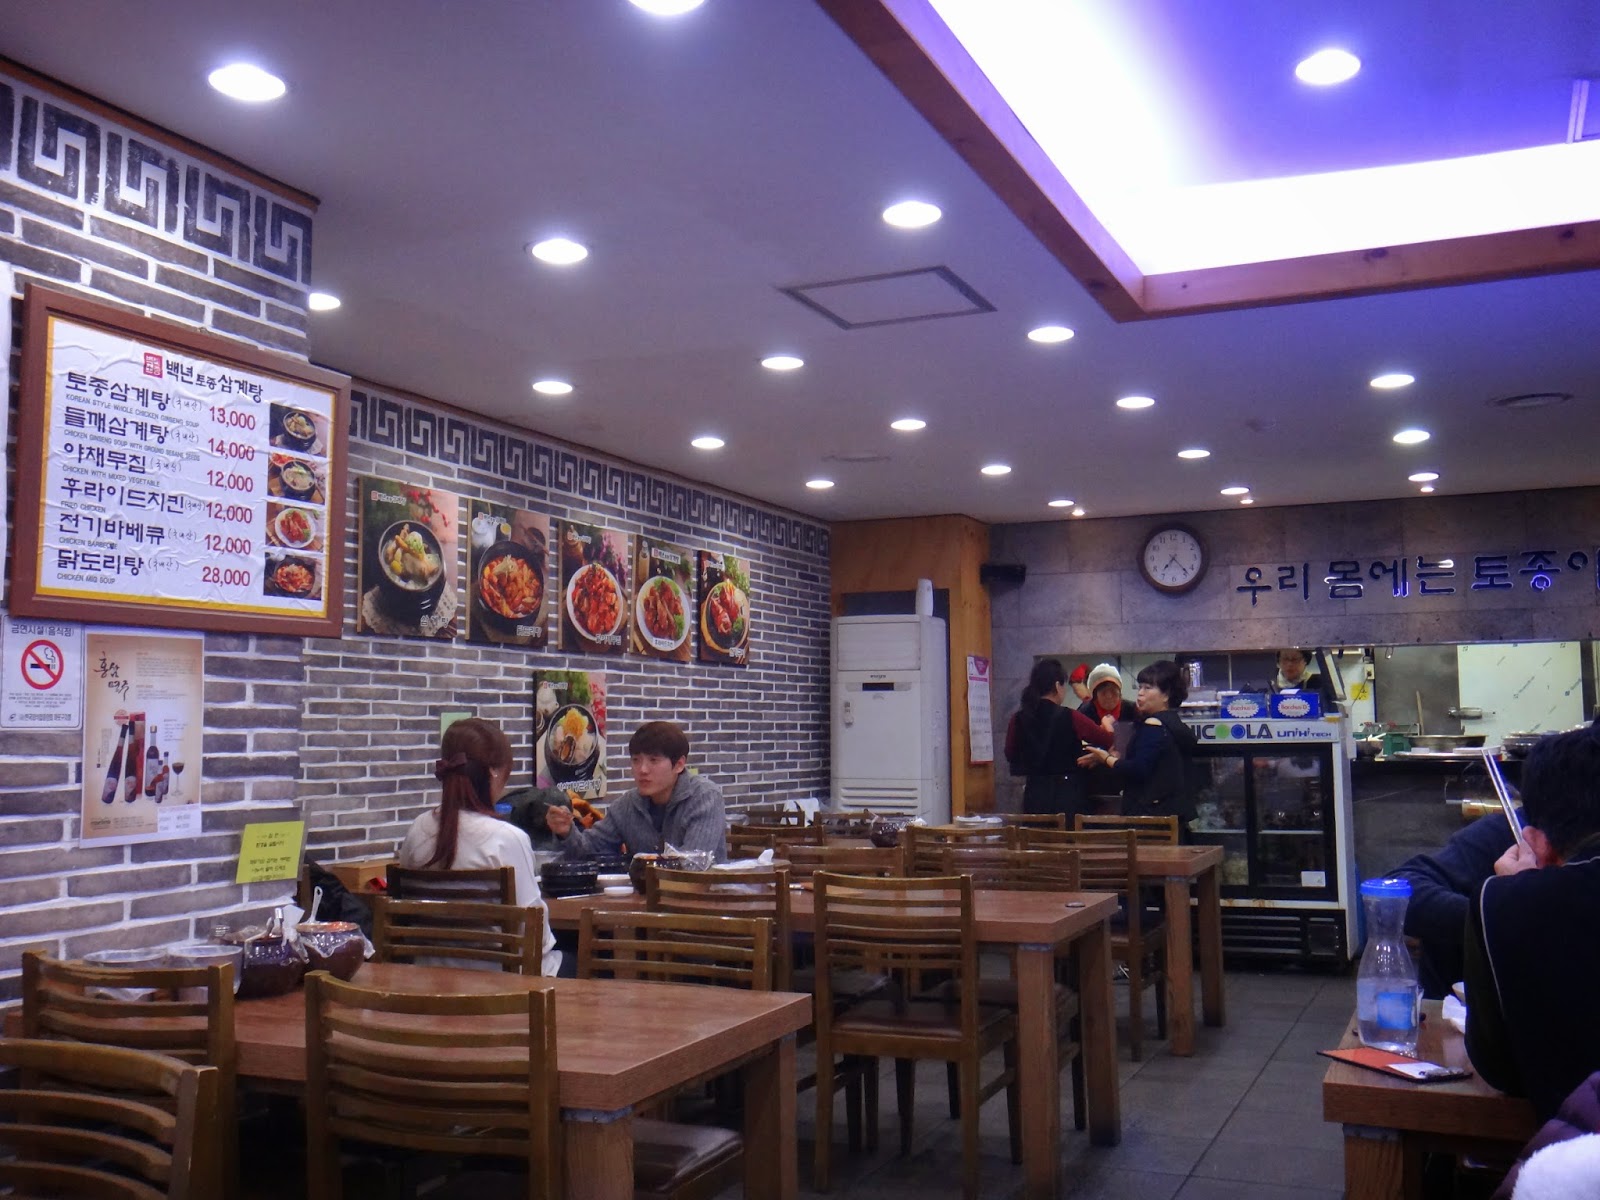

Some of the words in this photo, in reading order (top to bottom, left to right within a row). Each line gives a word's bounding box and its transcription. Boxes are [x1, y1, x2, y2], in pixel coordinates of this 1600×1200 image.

[65, 372, 170, 411] 토종삼계탕
[66, 394, 91, 405] KOREAN
[92, 400, 111, 409] STYLE
[113, 404, 133, 414] WHOLE
[135, 408, 159, 420] CHICKEN
[186, 420, 200, 428] SOUP
[209, 406, 256, 430] 13,000
[64, 406, 170, 444] 들깨삼계탕
[64, 428, 88, 439] CHICKEN
[114, 438, 128, 446] SOUP
[130, 442, 142, 450] WITH
[208, 438, 255, 461] 14,000
[64, 442, 146, 474] 야채무침
[62, 464, 89, 475] CHICKEN
[91, 470, 107, 478] WITH
[128, 476, 160, 487] VEGETABLE
[206, 470, 254, 492] 12,000
[60, 500, 78, 510] FRIED
[80, 504, 106, 513] CHICKEN
[61, 477, 184, 514] 후라이드치킨
[206, 502, 252, 524] 12,000
[59, 512, 165, 546] 전기바베큐
[59, 536, 86, 546] CHICKEN
[204, 534, 251, 556] 12,000
[57, 549, 144, 576] 닭도리탕
[57, 572, 84, 582] CHICKEN
[202, 566, 250, 587] 28,000
[1236, 562, 1310, 607] 우리
[1324, 555, 1456, 600] 몸에는
